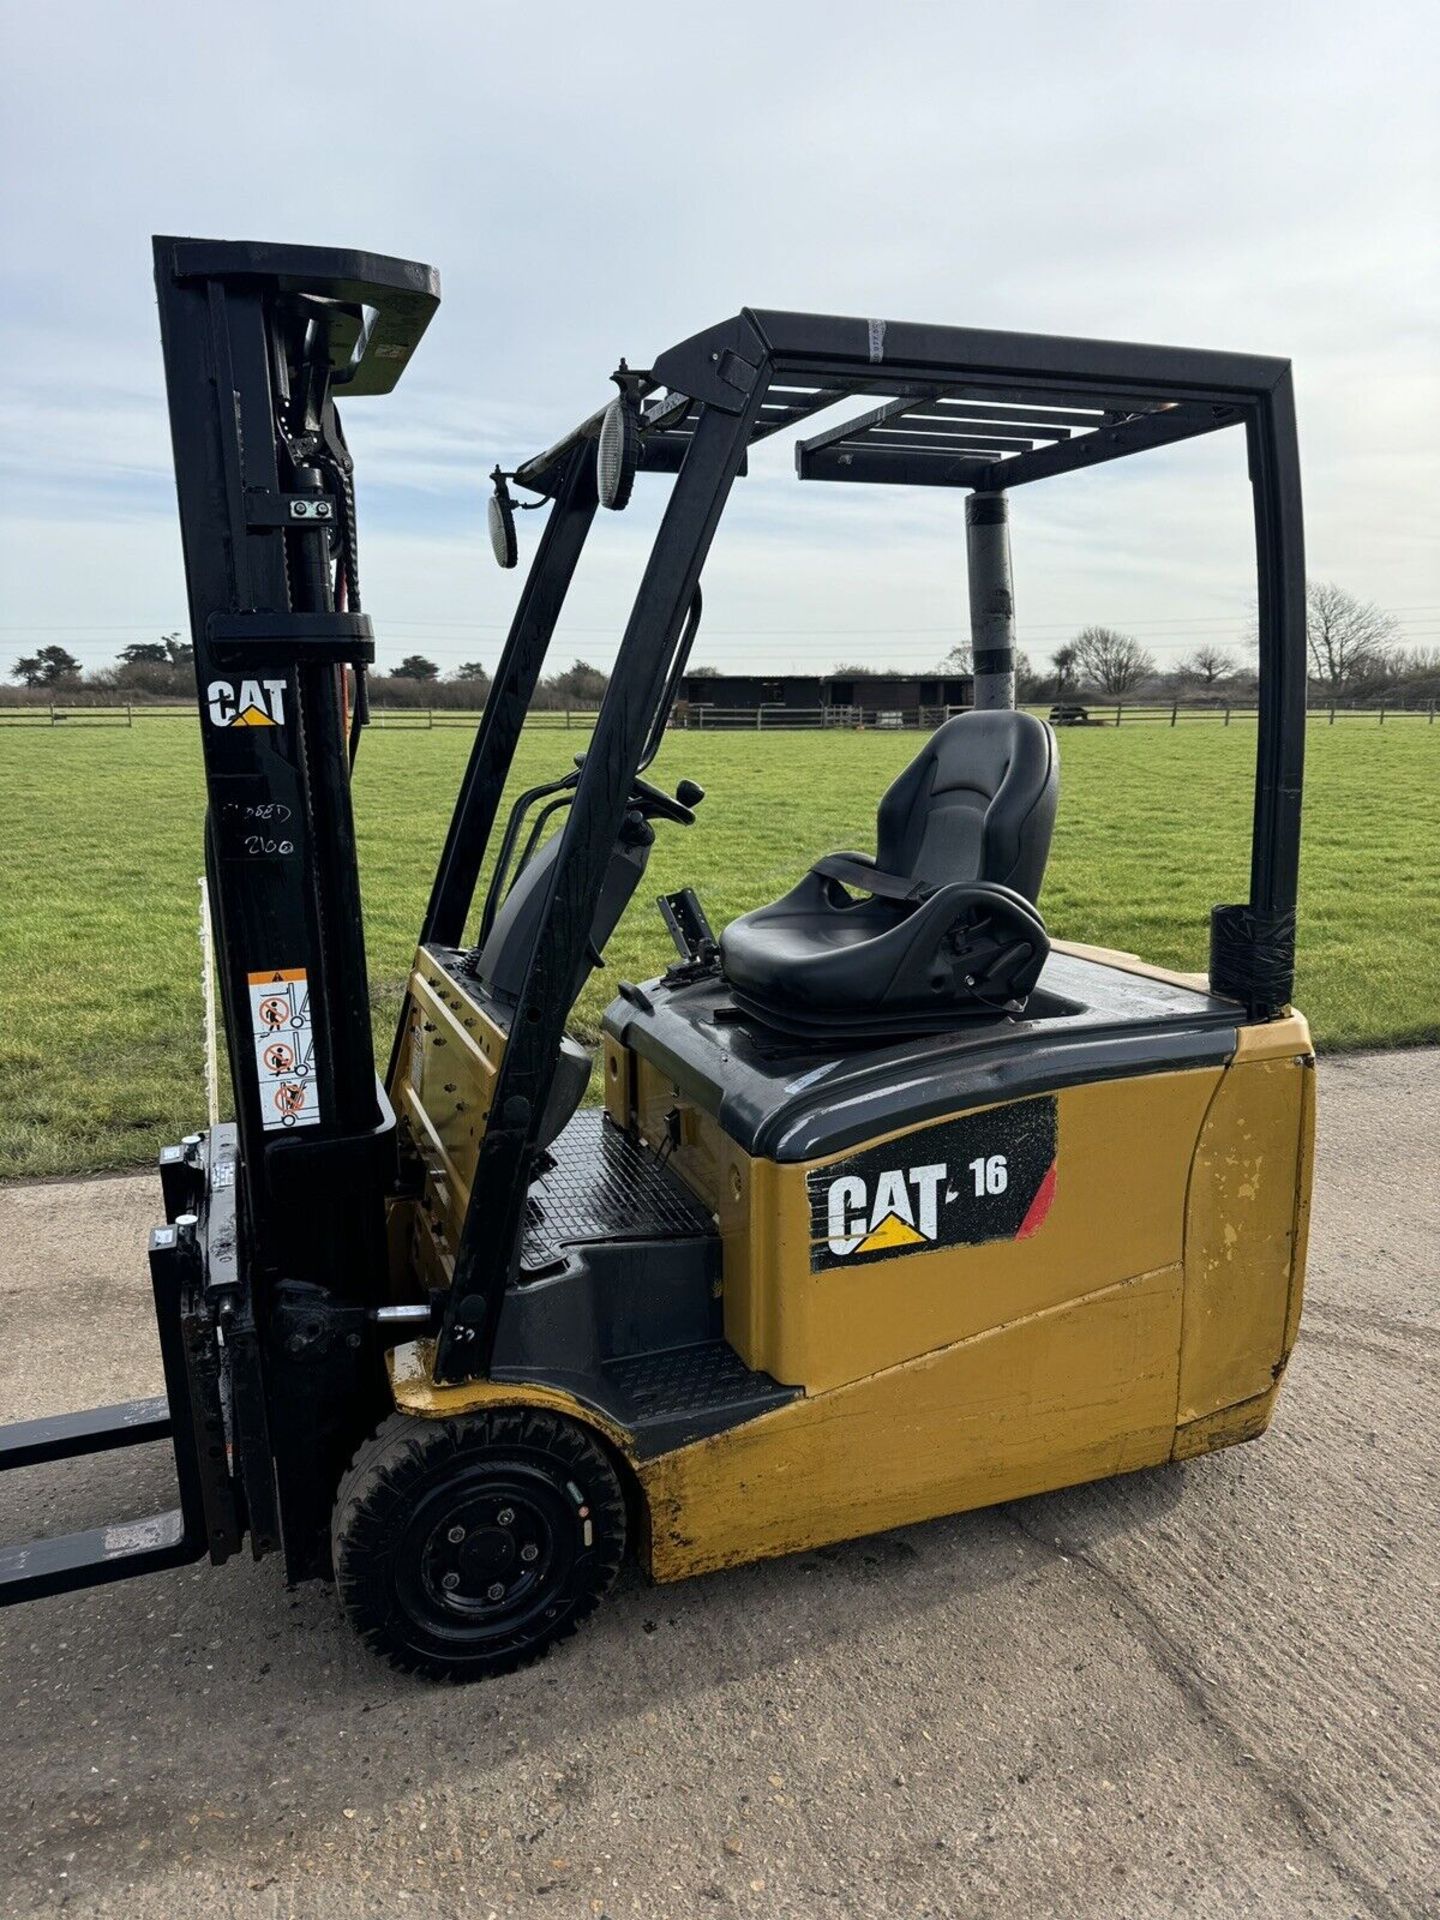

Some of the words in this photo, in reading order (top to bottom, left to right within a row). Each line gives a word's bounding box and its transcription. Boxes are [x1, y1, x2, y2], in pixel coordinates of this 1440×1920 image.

[207, 680, 287, 727] CAT
[827, 1163, 948, 1256] CAT
[969, 1154, 1008, 1197] 16
